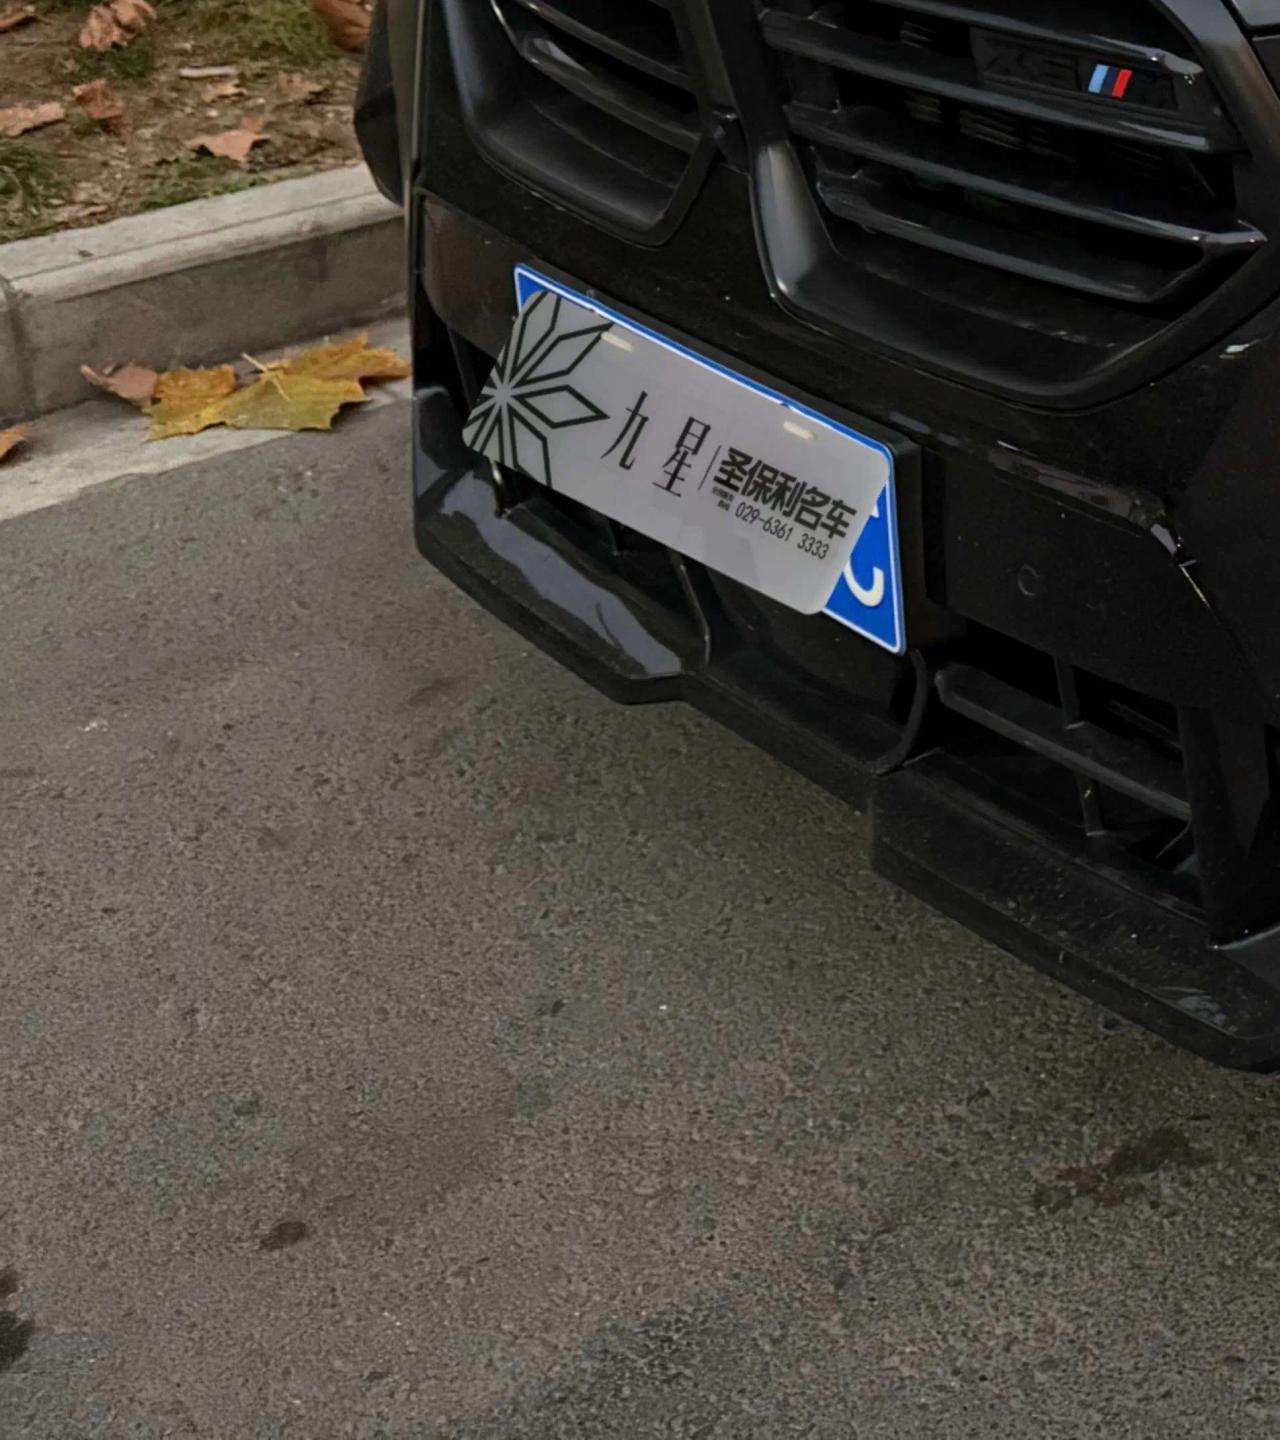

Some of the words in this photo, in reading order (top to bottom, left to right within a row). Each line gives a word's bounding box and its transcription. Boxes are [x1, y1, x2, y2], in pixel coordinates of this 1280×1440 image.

[601, 391, 711, 497] 九星
[713, 447, 857, 539] 圣保利名车
[735, 501, 794, 542] 029-6361
[797, 533, 829, 560] 3333
